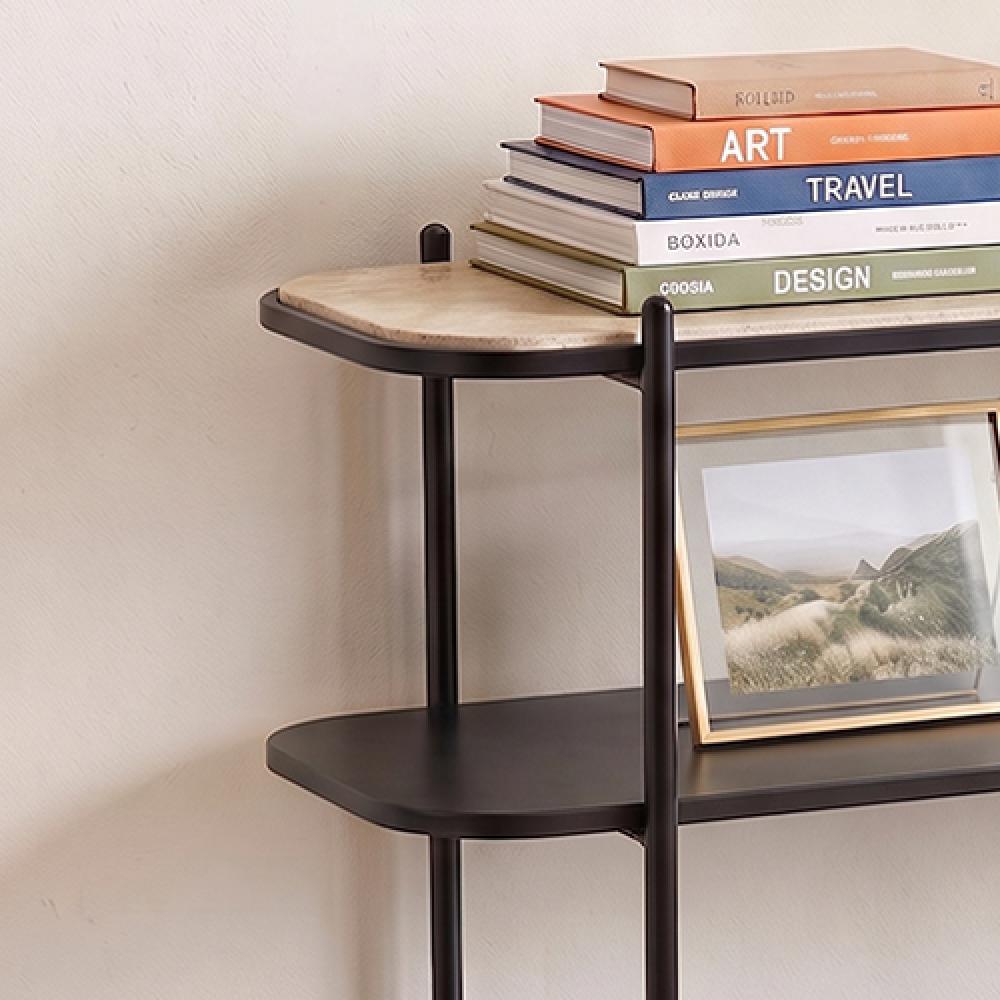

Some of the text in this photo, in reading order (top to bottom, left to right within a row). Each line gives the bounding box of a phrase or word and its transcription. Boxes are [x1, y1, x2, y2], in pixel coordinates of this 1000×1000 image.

[720, 127, 793, 162] ART
[806, 173, 913, 203] TRAVEL
[667, 232, 741, 250] BOXIDA
[773, 265, 872, 295] DESIGN
